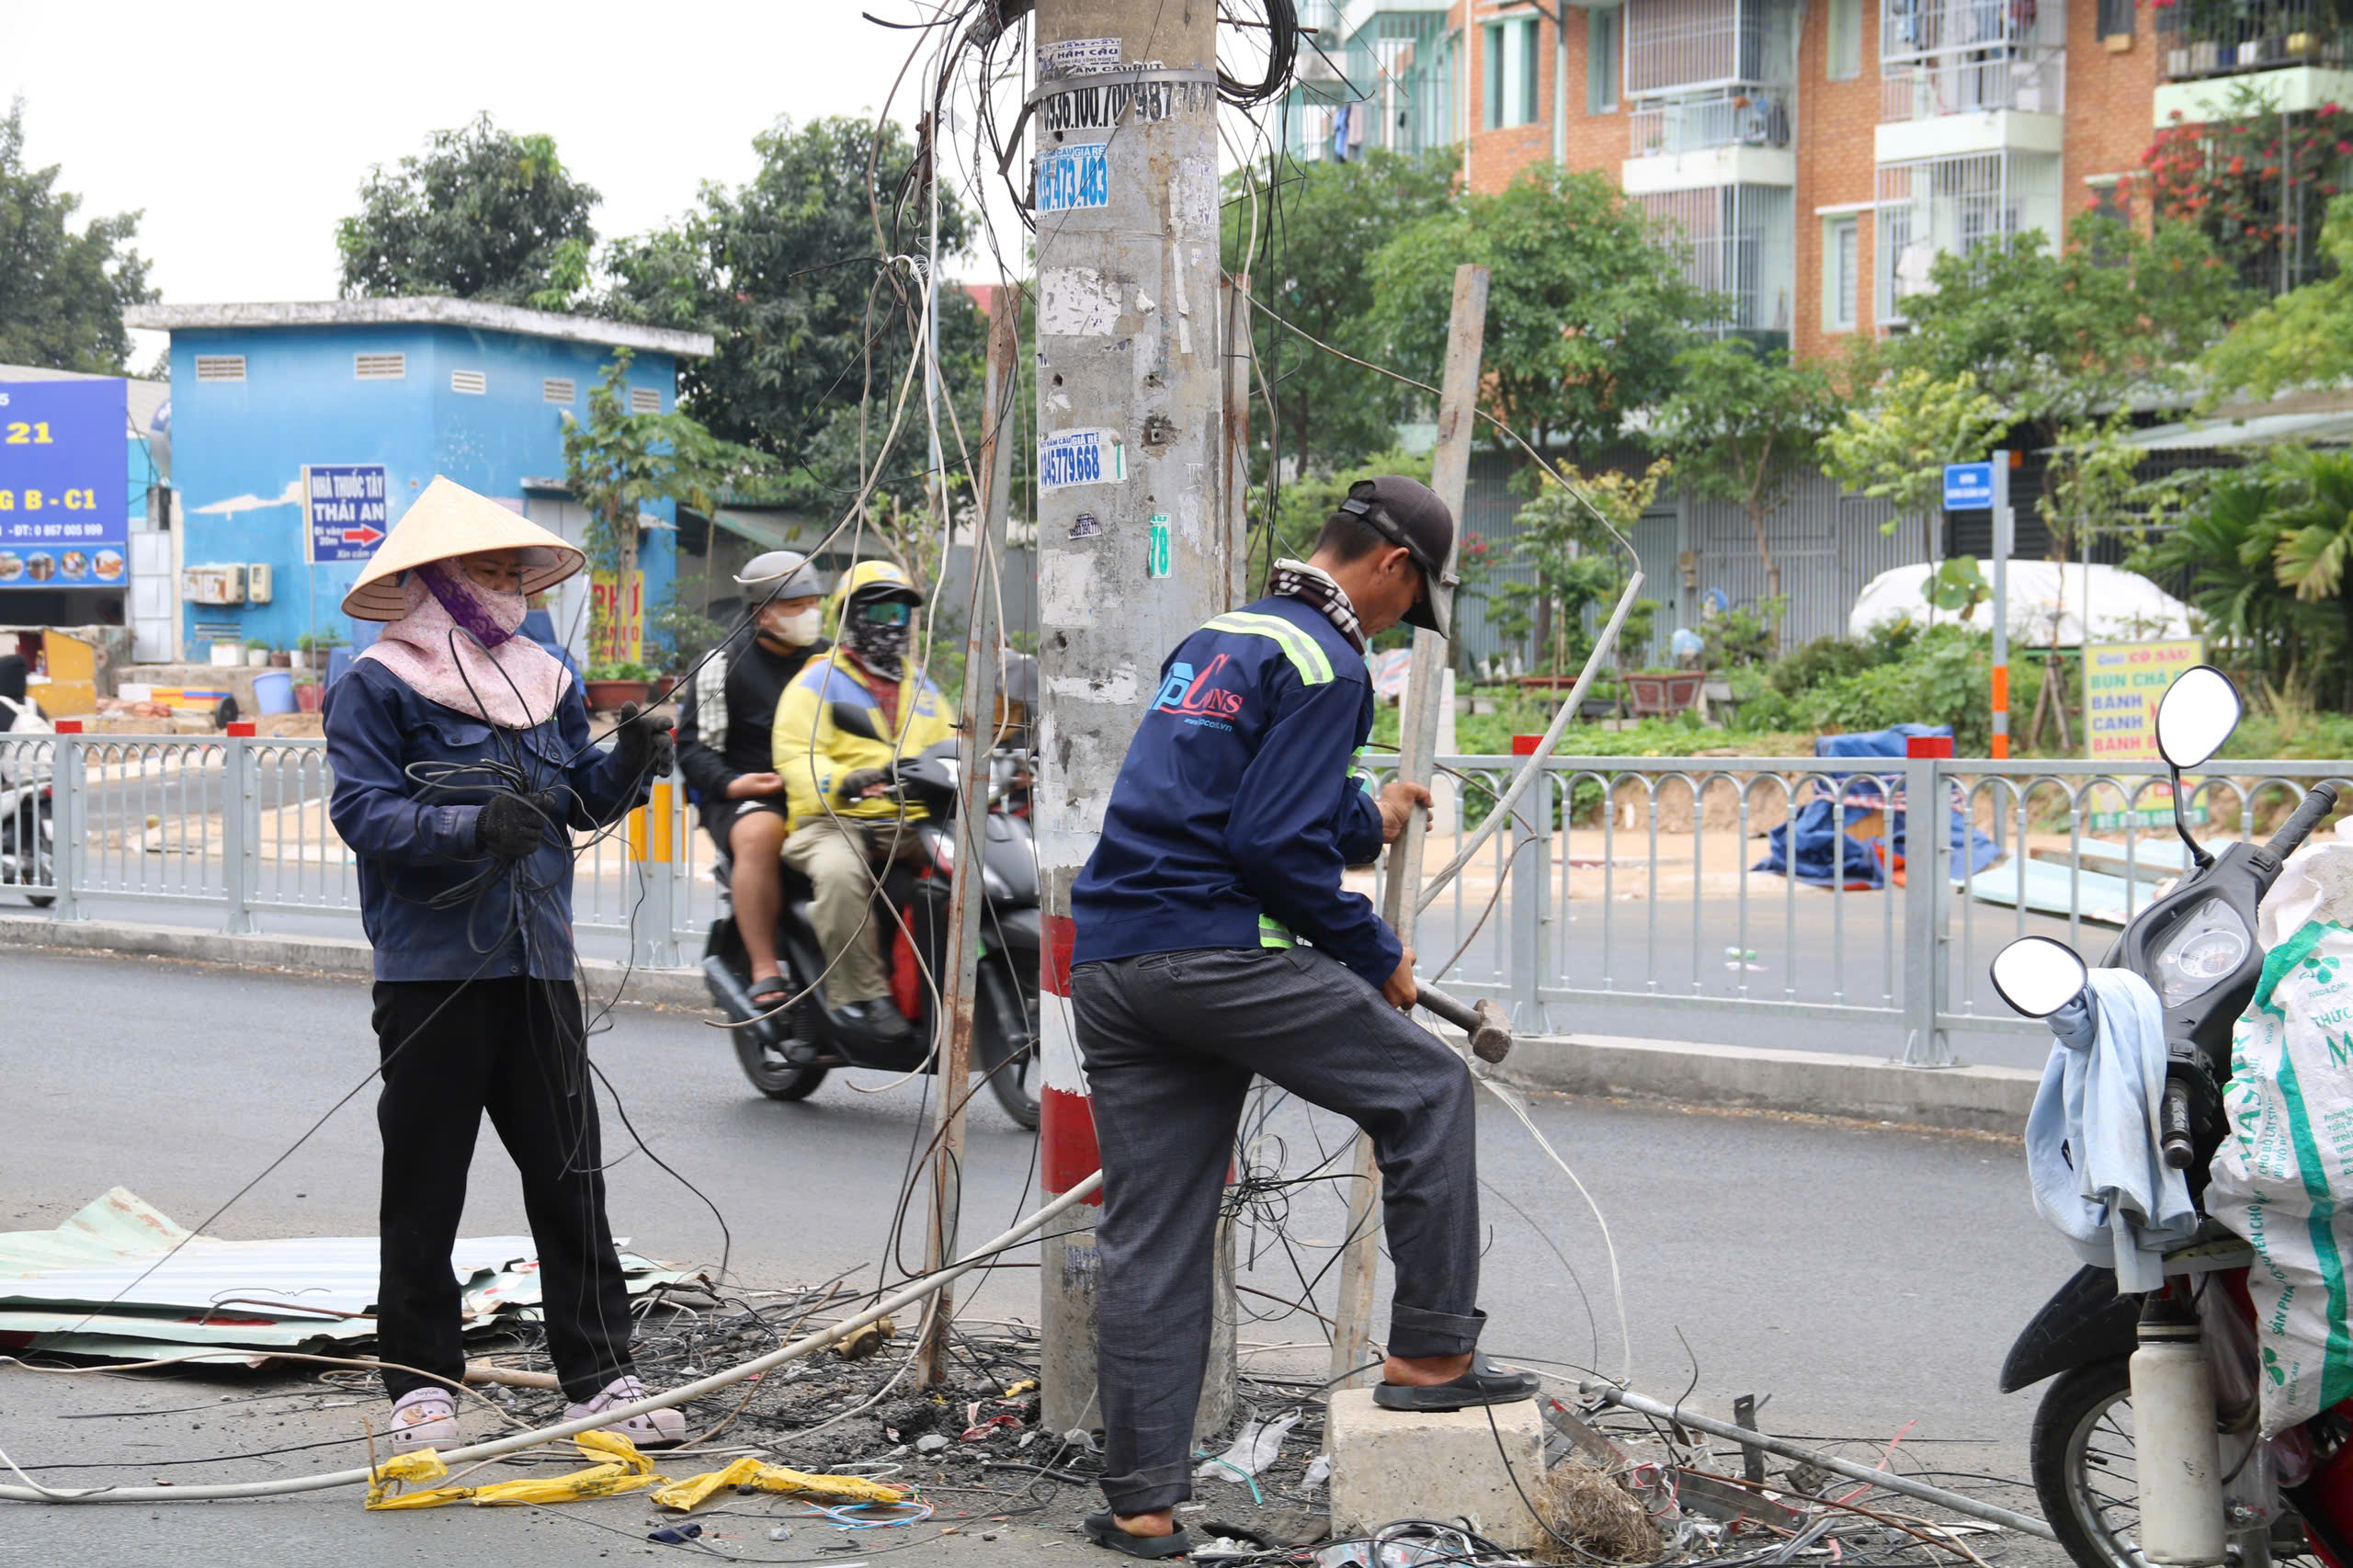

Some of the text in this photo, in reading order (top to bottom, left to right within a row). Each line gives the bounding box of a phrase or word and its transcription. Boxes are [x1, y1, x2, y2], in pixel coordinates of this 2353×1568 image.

[6, 422, 53, 444] 21
[313, 499, 385, 521] THÁI AN
[2256, 1153, 2269, 1176] CHO
